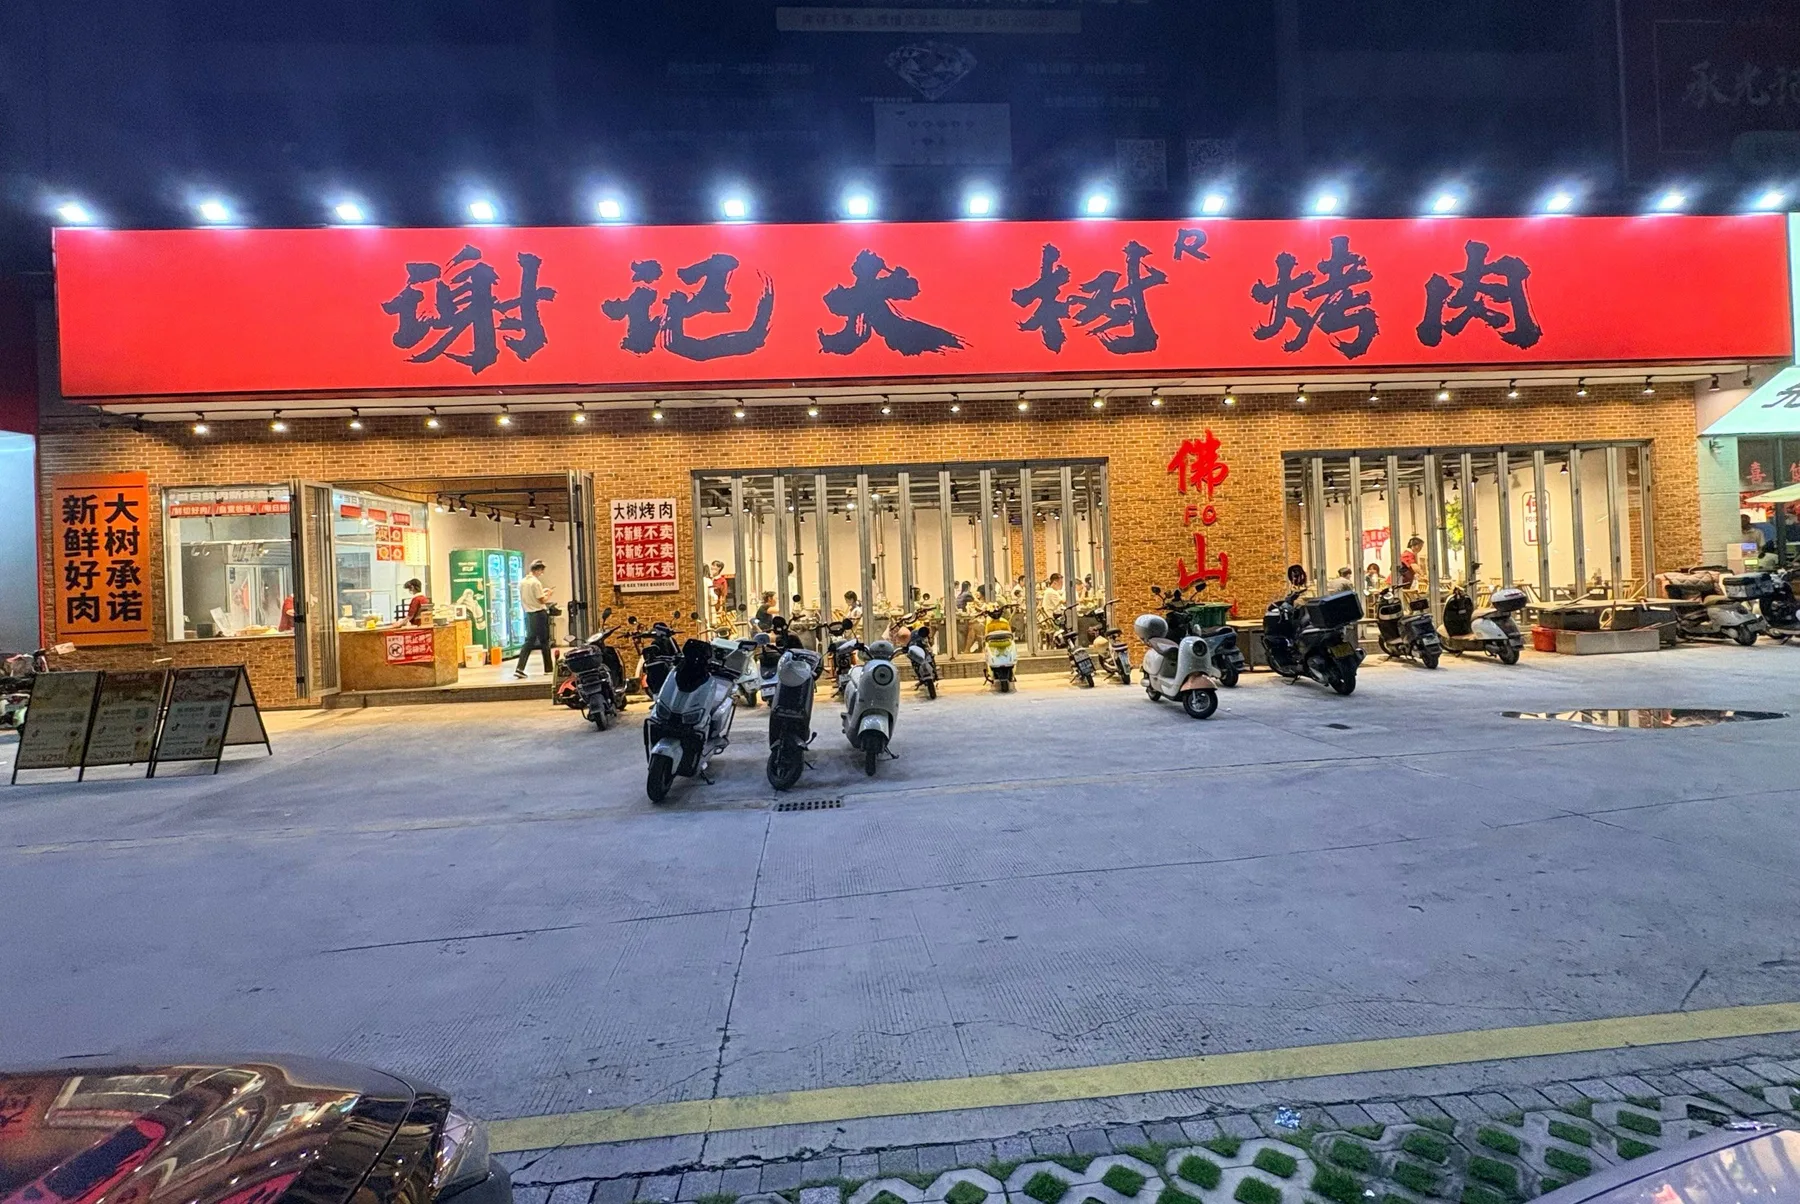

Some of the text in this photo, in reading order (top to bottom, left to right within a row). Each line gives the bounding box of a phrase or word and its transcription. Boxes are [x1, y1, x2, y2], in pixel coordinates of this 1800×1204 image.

[1173, 228, 1210, 261] R
[381, 236, 1544, 375] 谢记大树烤肉
[1167, 428, 1229, 499] 佛
[614, 502, 673, 519] 大树烤肉
[615, 524, 673, 541] 不新鲜不卖
[1184, 504, 1217, 526] FO
[62, 494, 101, 624] 新鲜好肉
[103, 492, 143, 622] 大树承诺
[1177, 532, 1229, 589] 山
